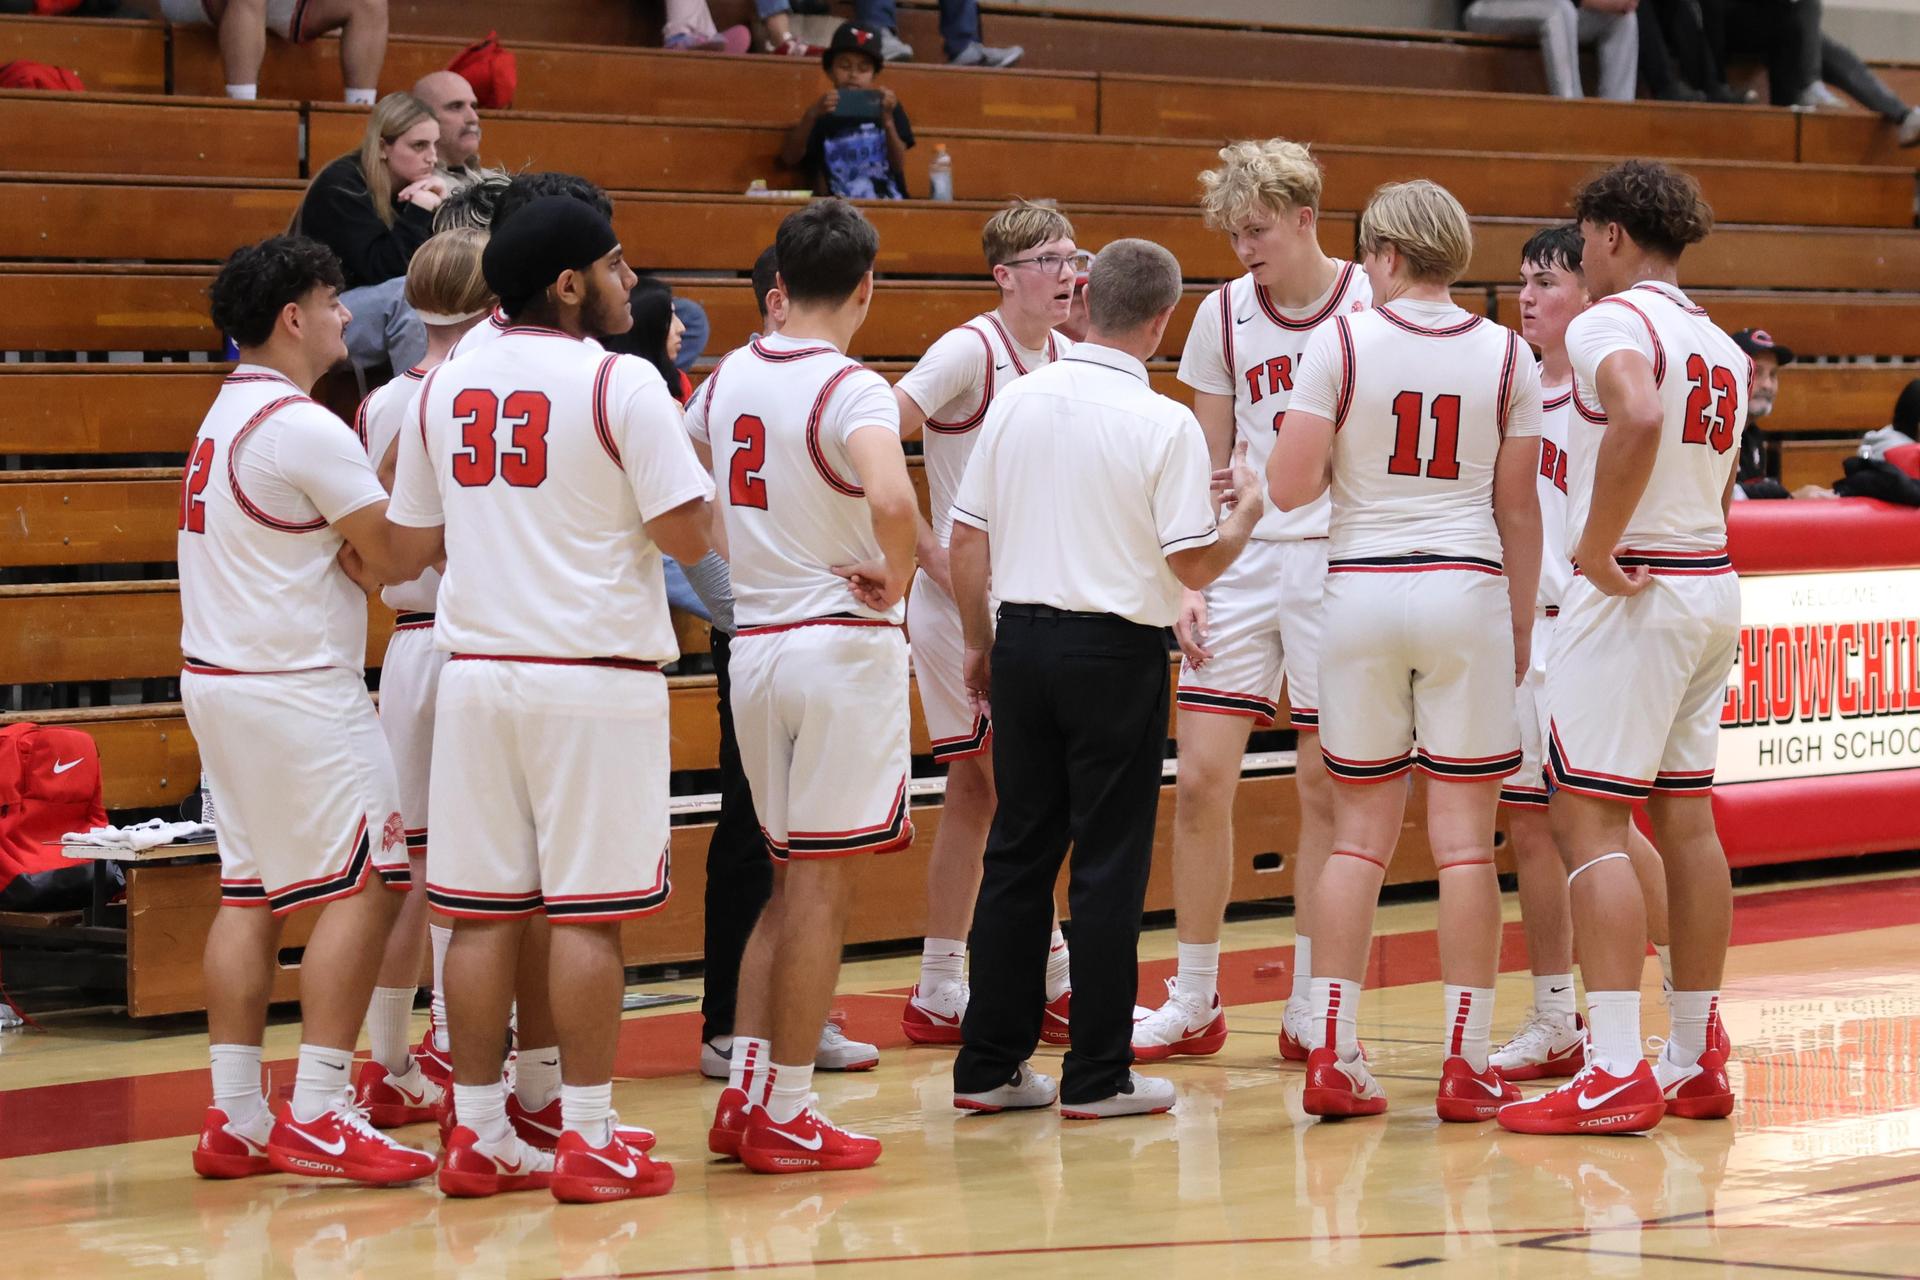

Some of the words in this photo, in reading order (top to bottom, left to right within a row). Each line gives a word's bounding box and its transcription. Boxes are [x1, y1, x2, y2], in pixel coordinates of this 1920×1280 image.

[1245, 353, 1303, 405] TR
[1682, 353, 1738, 455] 23
[452, 388, 551, 489] 33
[729, 413, 768, 511] 2
[1388, 390, 1461, 480] 11
[1758, 735, 1823, 767] HIGH
